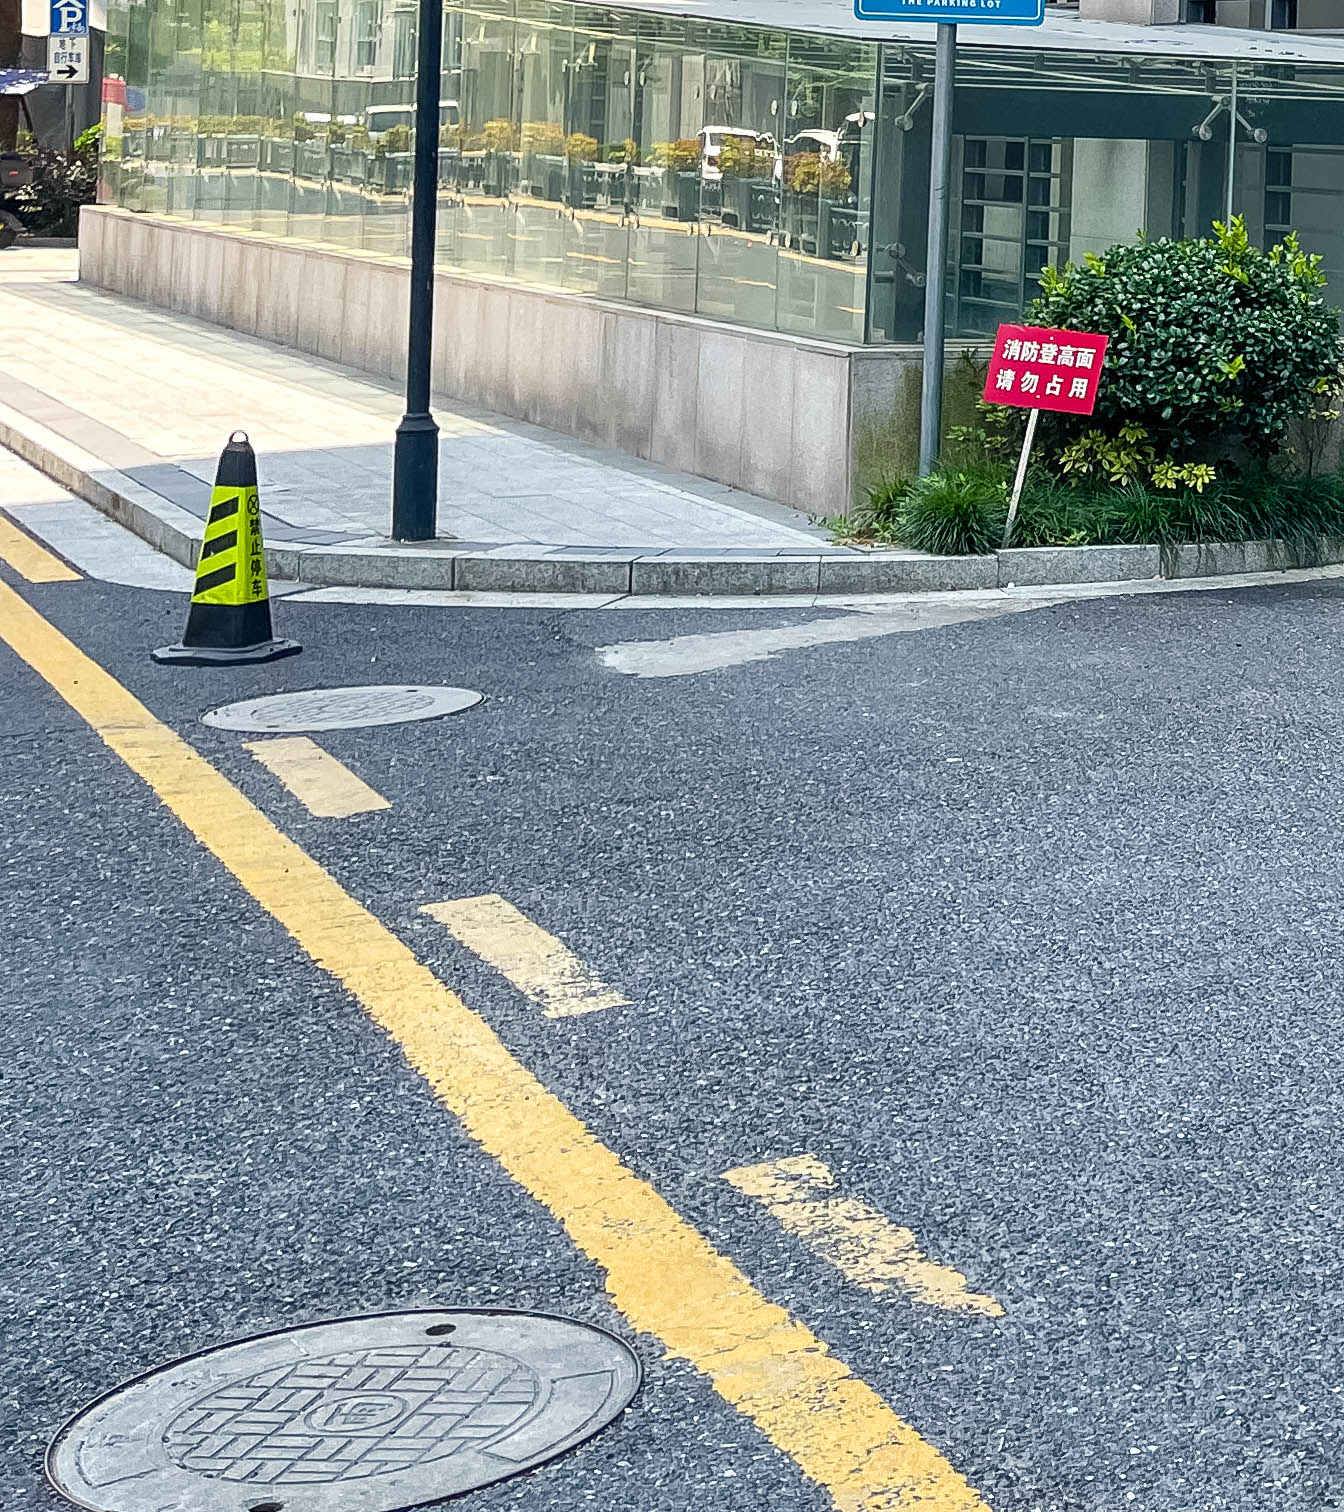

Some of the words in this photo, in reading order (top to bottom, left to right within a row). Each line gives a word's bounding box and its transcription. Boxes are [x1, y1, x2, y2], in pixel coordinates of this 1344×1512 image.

[59, 7, 83, 32] P
[980, 0, 1001, 8] LOT
[1002, 338, 1097, 369] 消防登高面
[995, 368, 1089, 399] 请勿占用
[248, 518, 262, 598] 禁止停车
